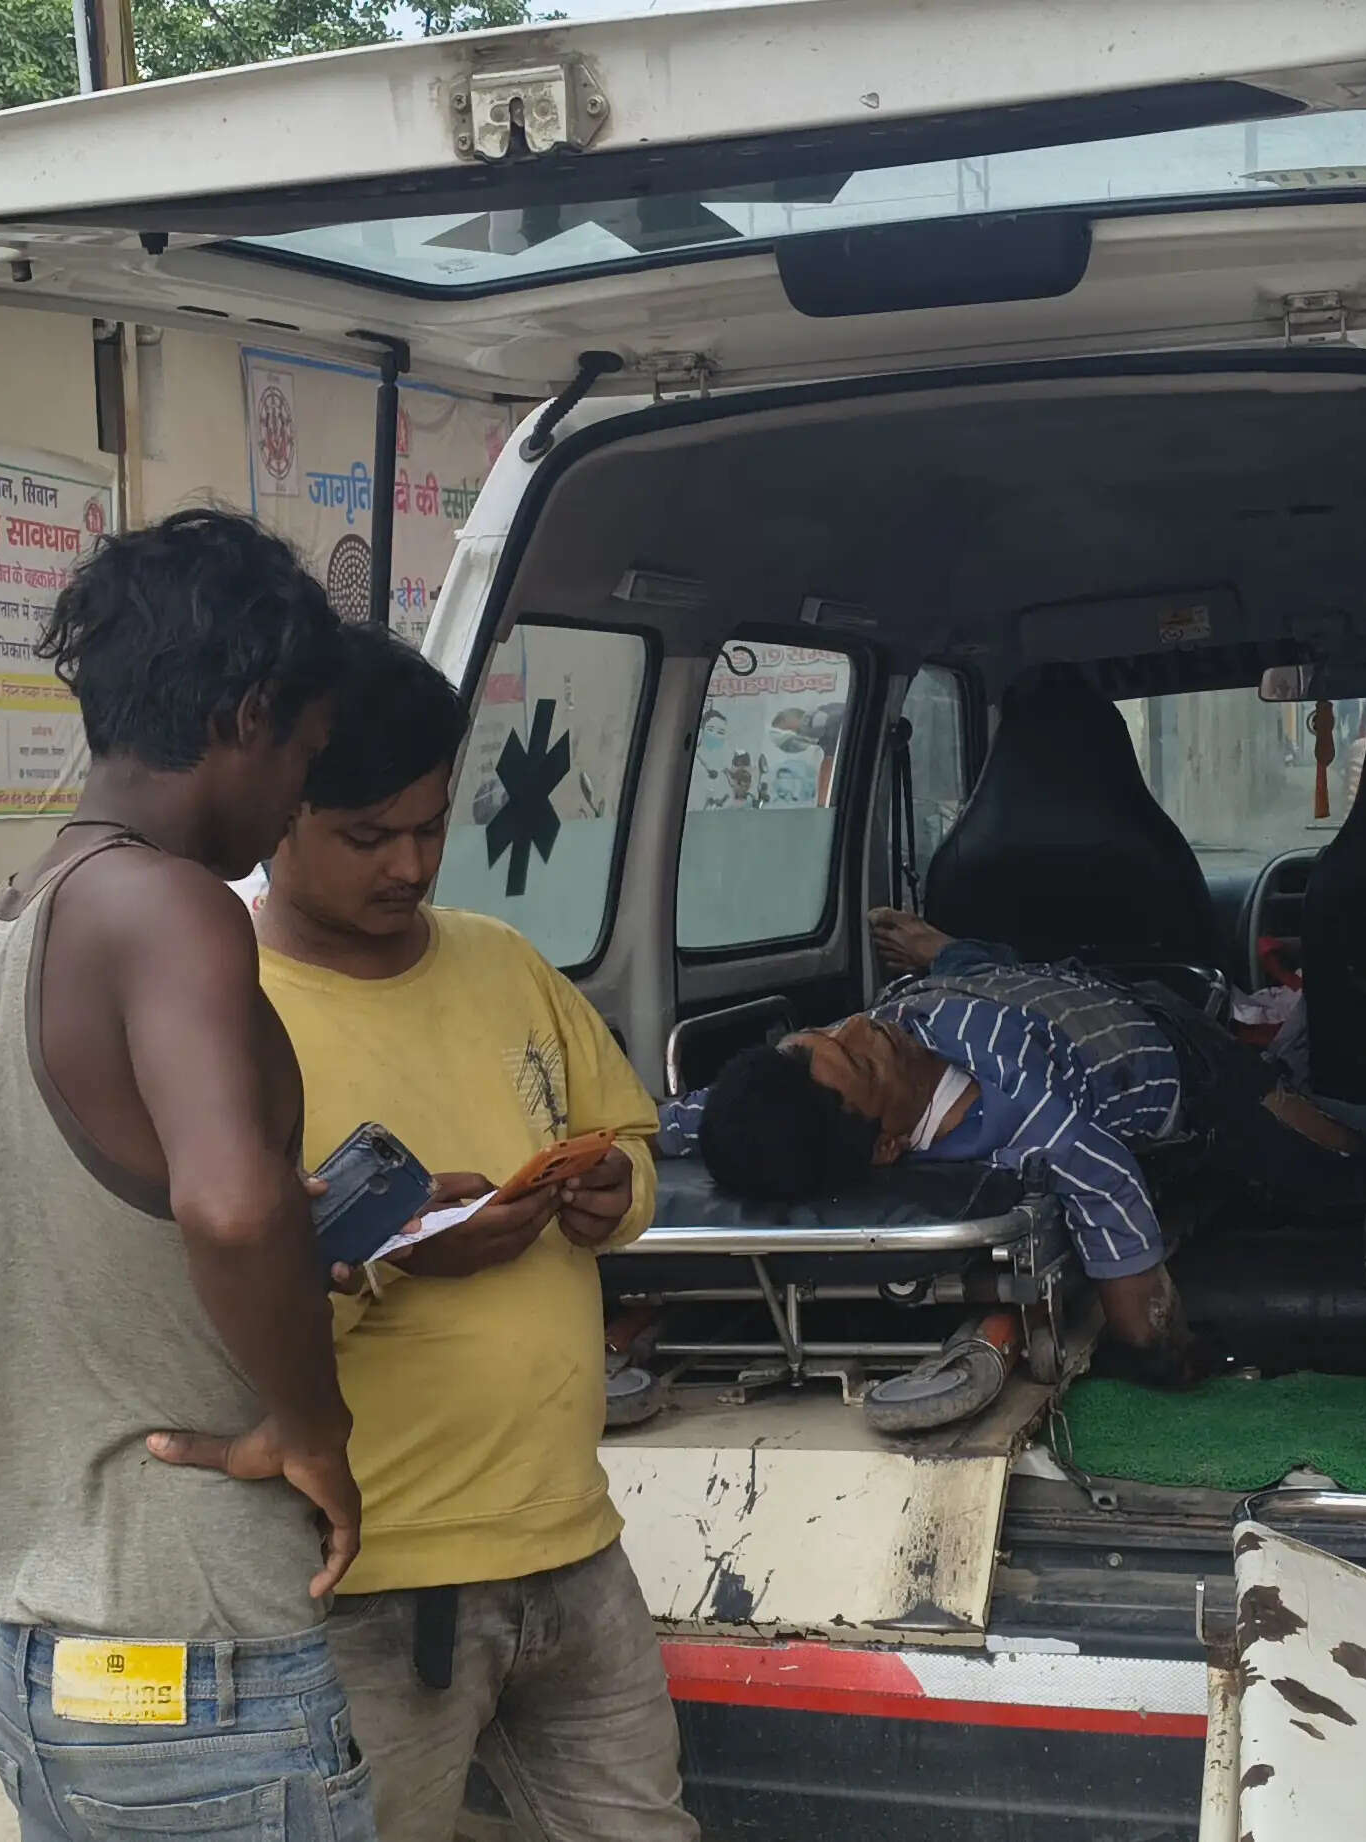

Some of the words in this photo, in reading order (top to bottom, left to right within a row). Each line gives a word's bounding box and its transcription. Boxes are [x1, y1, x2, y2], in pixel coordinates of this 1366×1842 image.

[22, 477, 58, 509] सिवान
[305, 461, 372, 524] जागृति
[415, 472, 439, 516] की
[6, 515, 81, 553] सावधान
[12, 560, 23, 583] के
